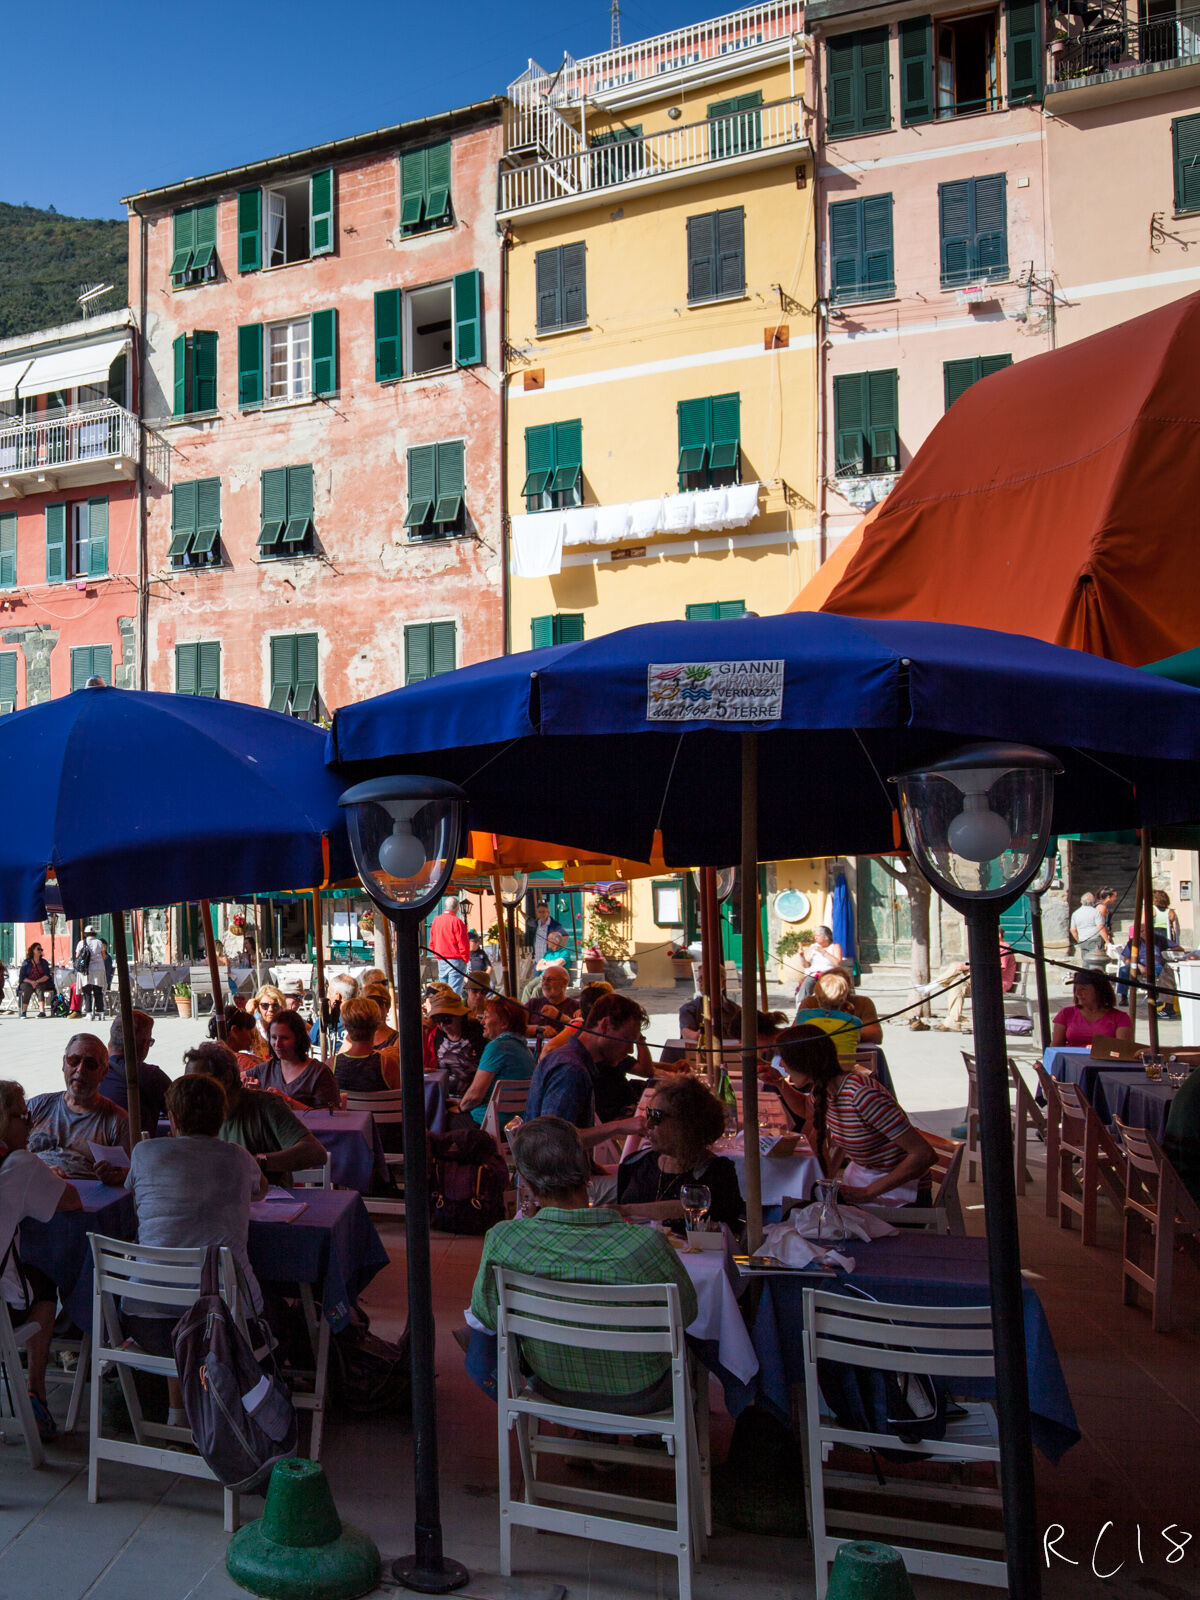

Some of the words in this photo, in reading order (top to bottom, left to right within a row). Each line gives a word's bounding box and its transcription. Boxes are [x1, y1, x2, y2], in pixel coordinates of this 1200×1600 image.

[719, 662, 779, 674] GIANNI
[718, 689, 777, 697] VERNAZZA
[653, 704, 674, 717] dal
[678, 704, 709, 717] 1964
[716, 700, 727, 718] 5
[733, 706, 777, 718] TERRE
